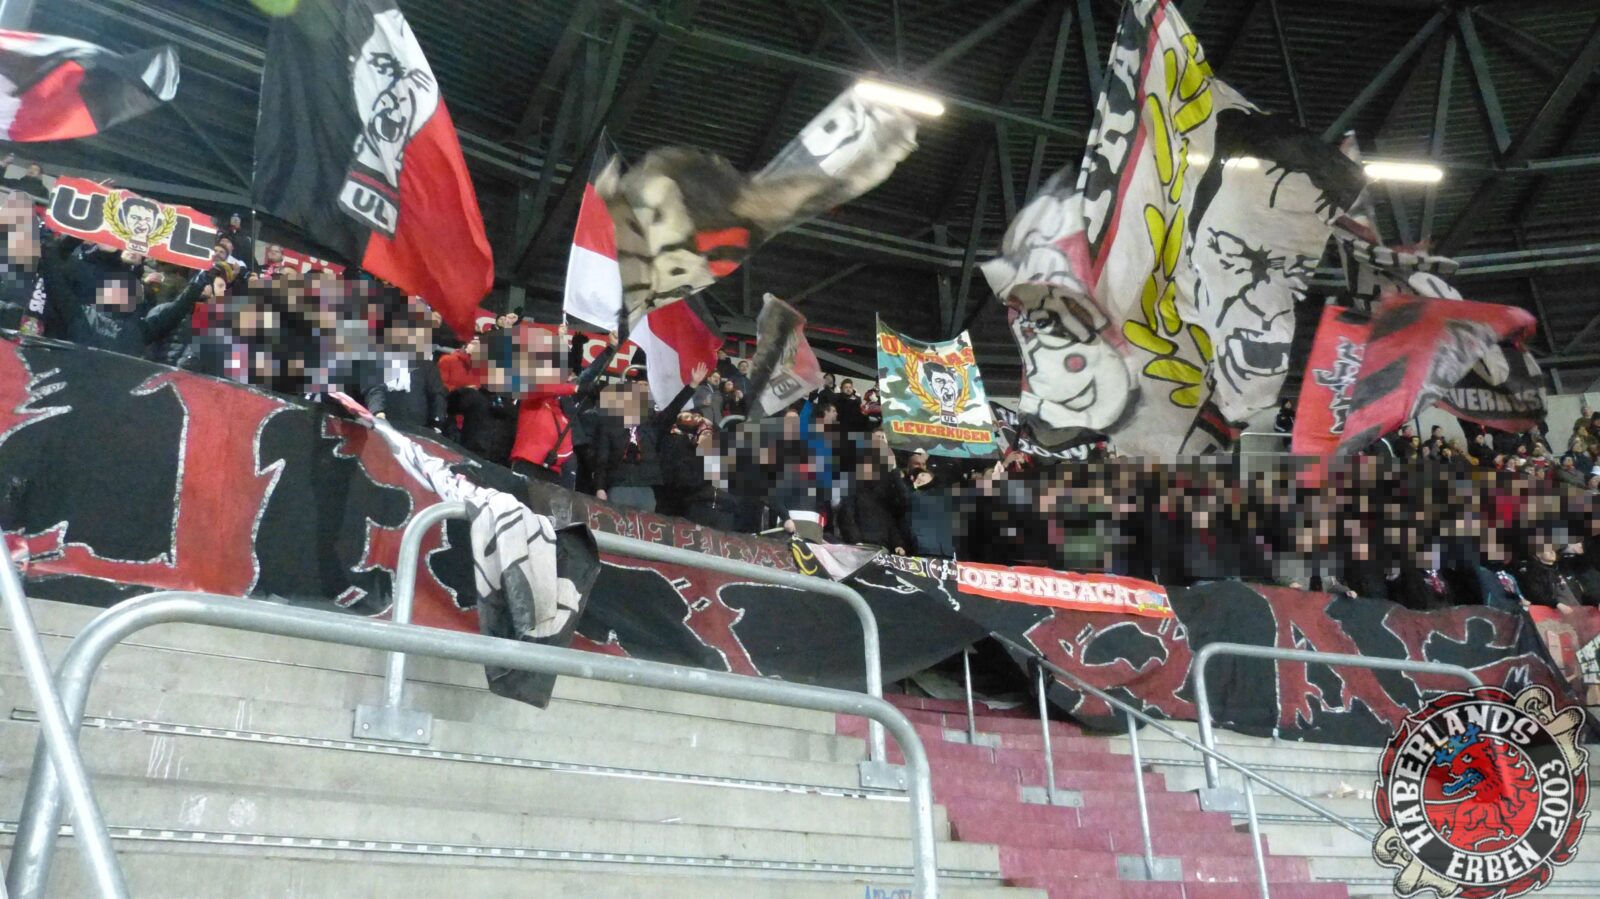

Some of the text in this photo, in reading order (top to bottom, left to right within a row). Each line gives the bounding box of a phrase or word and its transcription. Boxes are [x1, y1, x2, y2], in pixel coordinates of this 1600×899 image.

[351, 187, 390, 226] UL
[879, 332, 976, 367] URAS
[892, 420, 992, 443] LEVERKUSEN
[963, 567, 1133, 605] OFFENBACH
